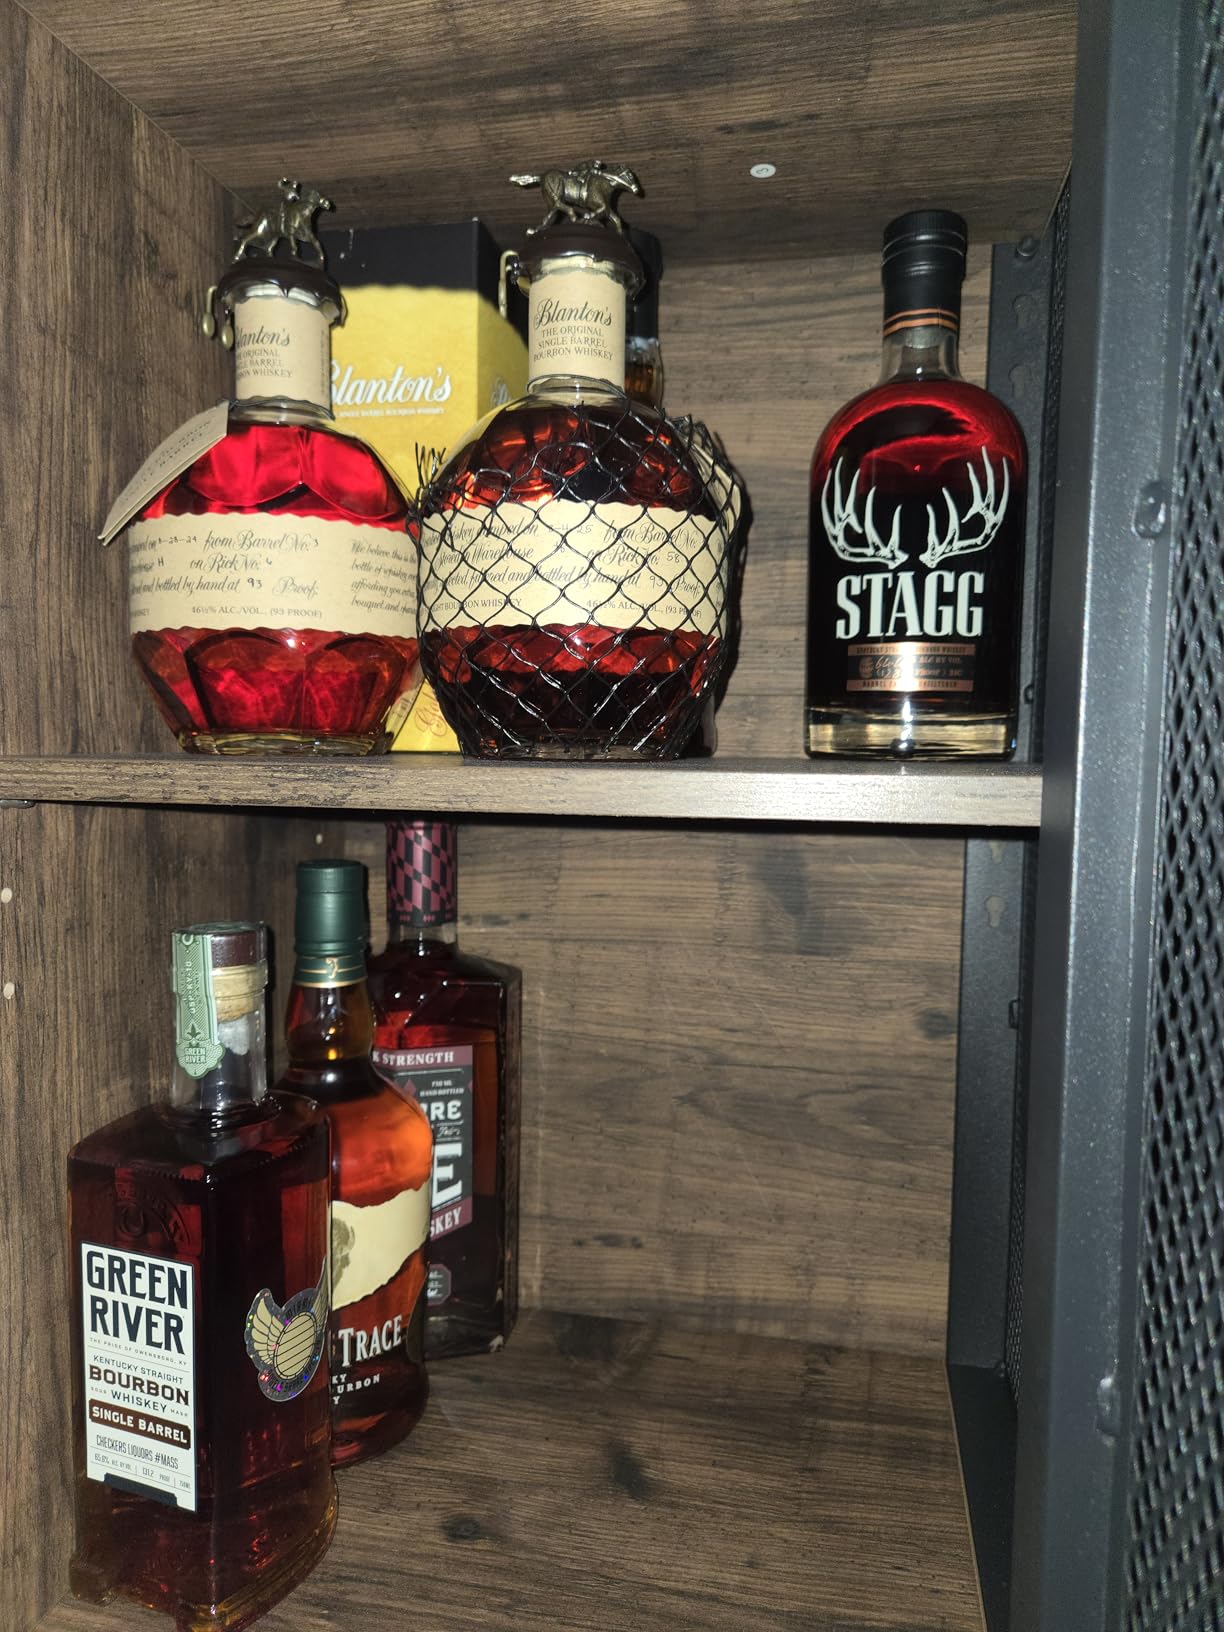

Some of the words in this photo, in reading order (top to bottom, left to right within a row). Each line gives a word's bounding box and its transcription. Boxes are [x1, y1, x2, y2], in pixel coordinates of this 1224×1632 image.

[535, 298, 612, 330] Blanton's
[538, 338, 568, 350] SINGLE
[570, 337, 608, 349] BARREL
[542, 328, 558, 338] THE
[560, 326, 604, 337] ORIGINAL
[574, 347, 613, 360] WHISKEY
[252, 368, 293, 378] WHISKEY
[202, 529, 233, 553] from
[233, 530, 286, 552] Barrel
[204, 551, 239, 574] Rick
[666, 551, 680, 564] 58
[154, 576, 181, 594] bottled
[181, 576, 194, 598] by
[195, 575, 226, 593] hand
[226, 576, 242, 593] at
[247, 577, 262, 589] 93
[444, 599, 479, 610] BOUBON
[480, 598, 522, 608] WHISEY
[836, 570, 984, 640] STAGG
[184, 1047, 207, 1056] GREEN
[184, 1055, 207, 1064] RIVER
[382, 1051, 455, 1067] STRENGTH
[86, 1250, 188, 1310] GREEN
[90, 1294, 186, 1356] RIVER
[338, 1314, 402, 1368] TRACE
[93, 1354, 139, 1373] KENTUCKY
[140, 1366, 184, 1385] STRAIGHT
[89, 1363, 190, 1407] BOURBON
[336, 1374, 380, 1394] URBON
[110, 1389, 167, 1414] WHISKEY
[92, 1406, 135, 1428] SINGLE
[138, 1418, 188, 1444] BARREL
[96, 1434, 127, 1454] CHECKERS
[127, 1444, 153, 1462] LIQUORS
[155, 1452, 179, 1470] #MASS
